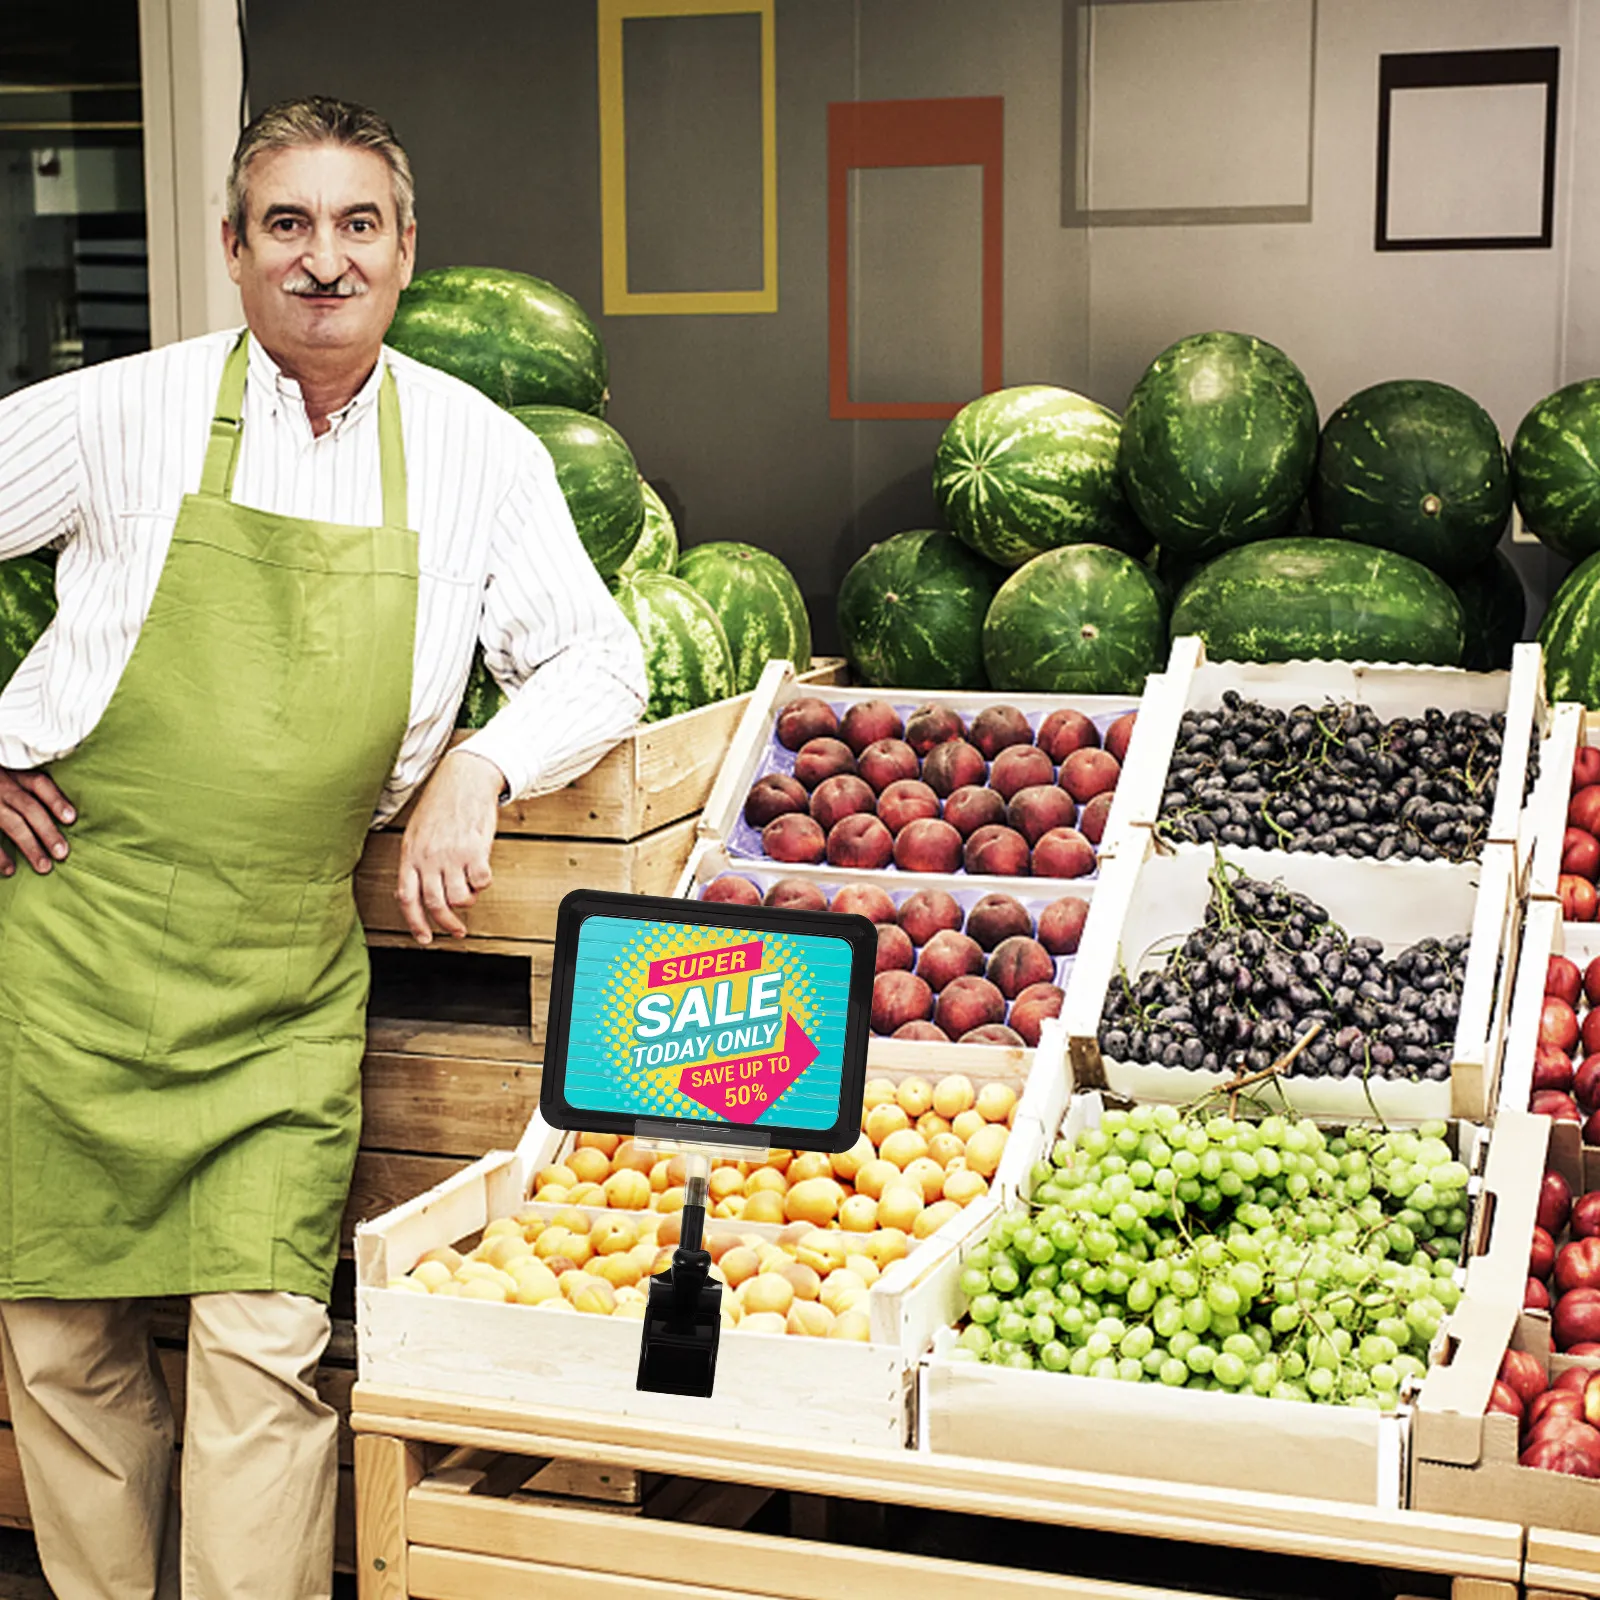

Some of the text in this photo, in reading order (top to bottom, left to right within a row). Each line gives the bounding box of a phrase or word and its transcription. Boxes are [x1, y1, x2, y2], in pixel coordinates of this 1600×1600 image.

[661, 951, 746, 981] SUPER
[636, 972, 782, 1038] SALE
[633, 1022, 778, 1068] TODAY ONLY
[691, 1055, 790, 1087] SAVE UP TO
[724, 1083, 768, 1107] 50%
